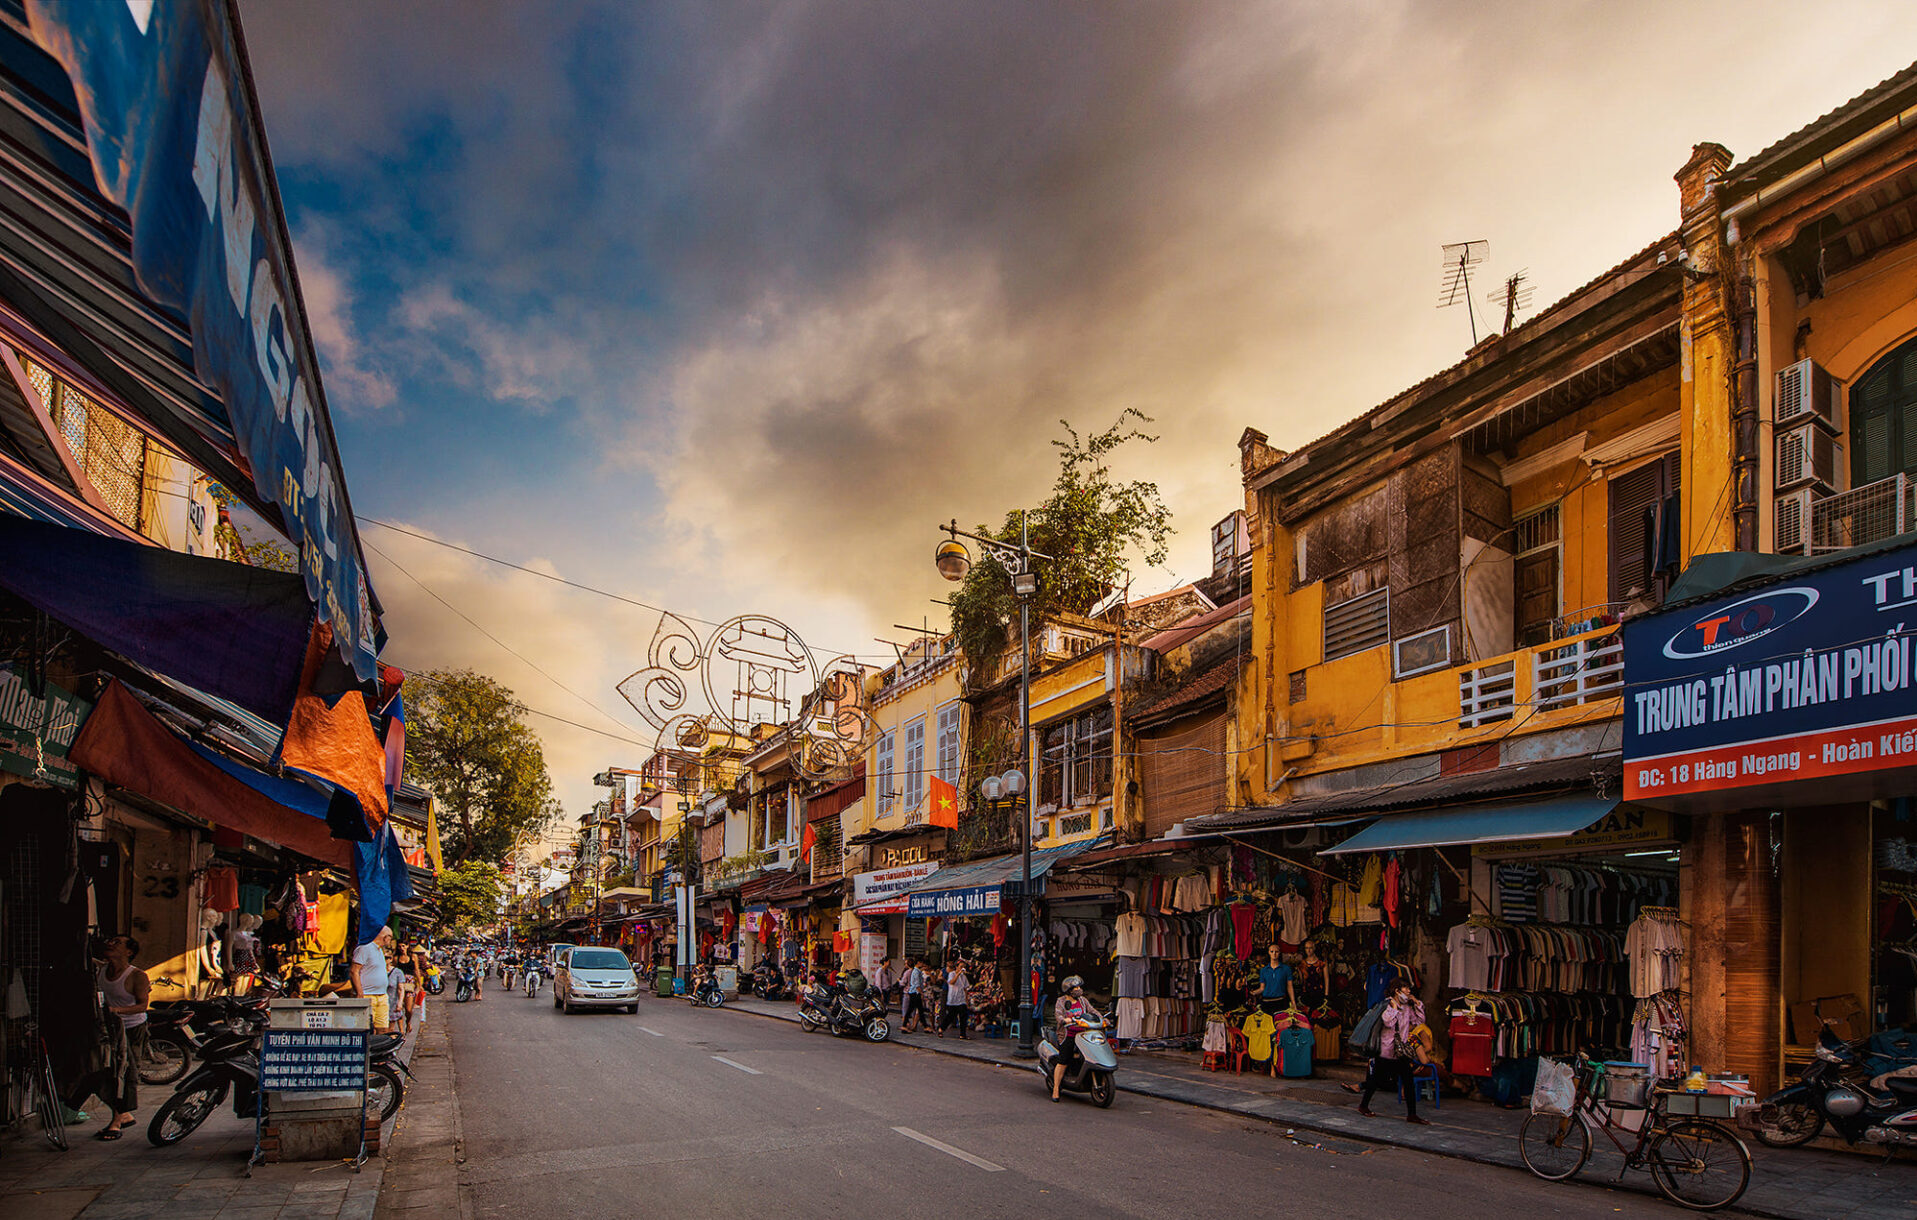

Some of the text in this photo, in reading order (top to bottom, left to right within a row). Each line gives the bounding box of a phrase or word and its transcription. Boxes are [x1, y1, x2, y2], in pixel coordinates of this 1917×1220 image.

[1635, 622, 1909, 735] TRUNG TÂM PHÂN PHỐI
[1639, 768, 1665, 788] ĐC:
[1670, 764, 1689, 784] 18
[1694, 760, 1737, 781] Hàng
[1742, 751, 1800, 775] Ngang
[1822, 738, 1873, 764] Hoàn
[1880, 728, 1917, 756] Kiế
[937, 892, 963, 912] HỒNG
[966, 889, 983, 910] HẢI
[269, 1032, 291, 1046] TUYẾN
[292, 1031, 306, 1046] PHỐ
[307, 1033, 320, 1046] VĂN
[321, 1035, 340, 1046] MINH
[352, 1035, 363, 1048] THỊ
